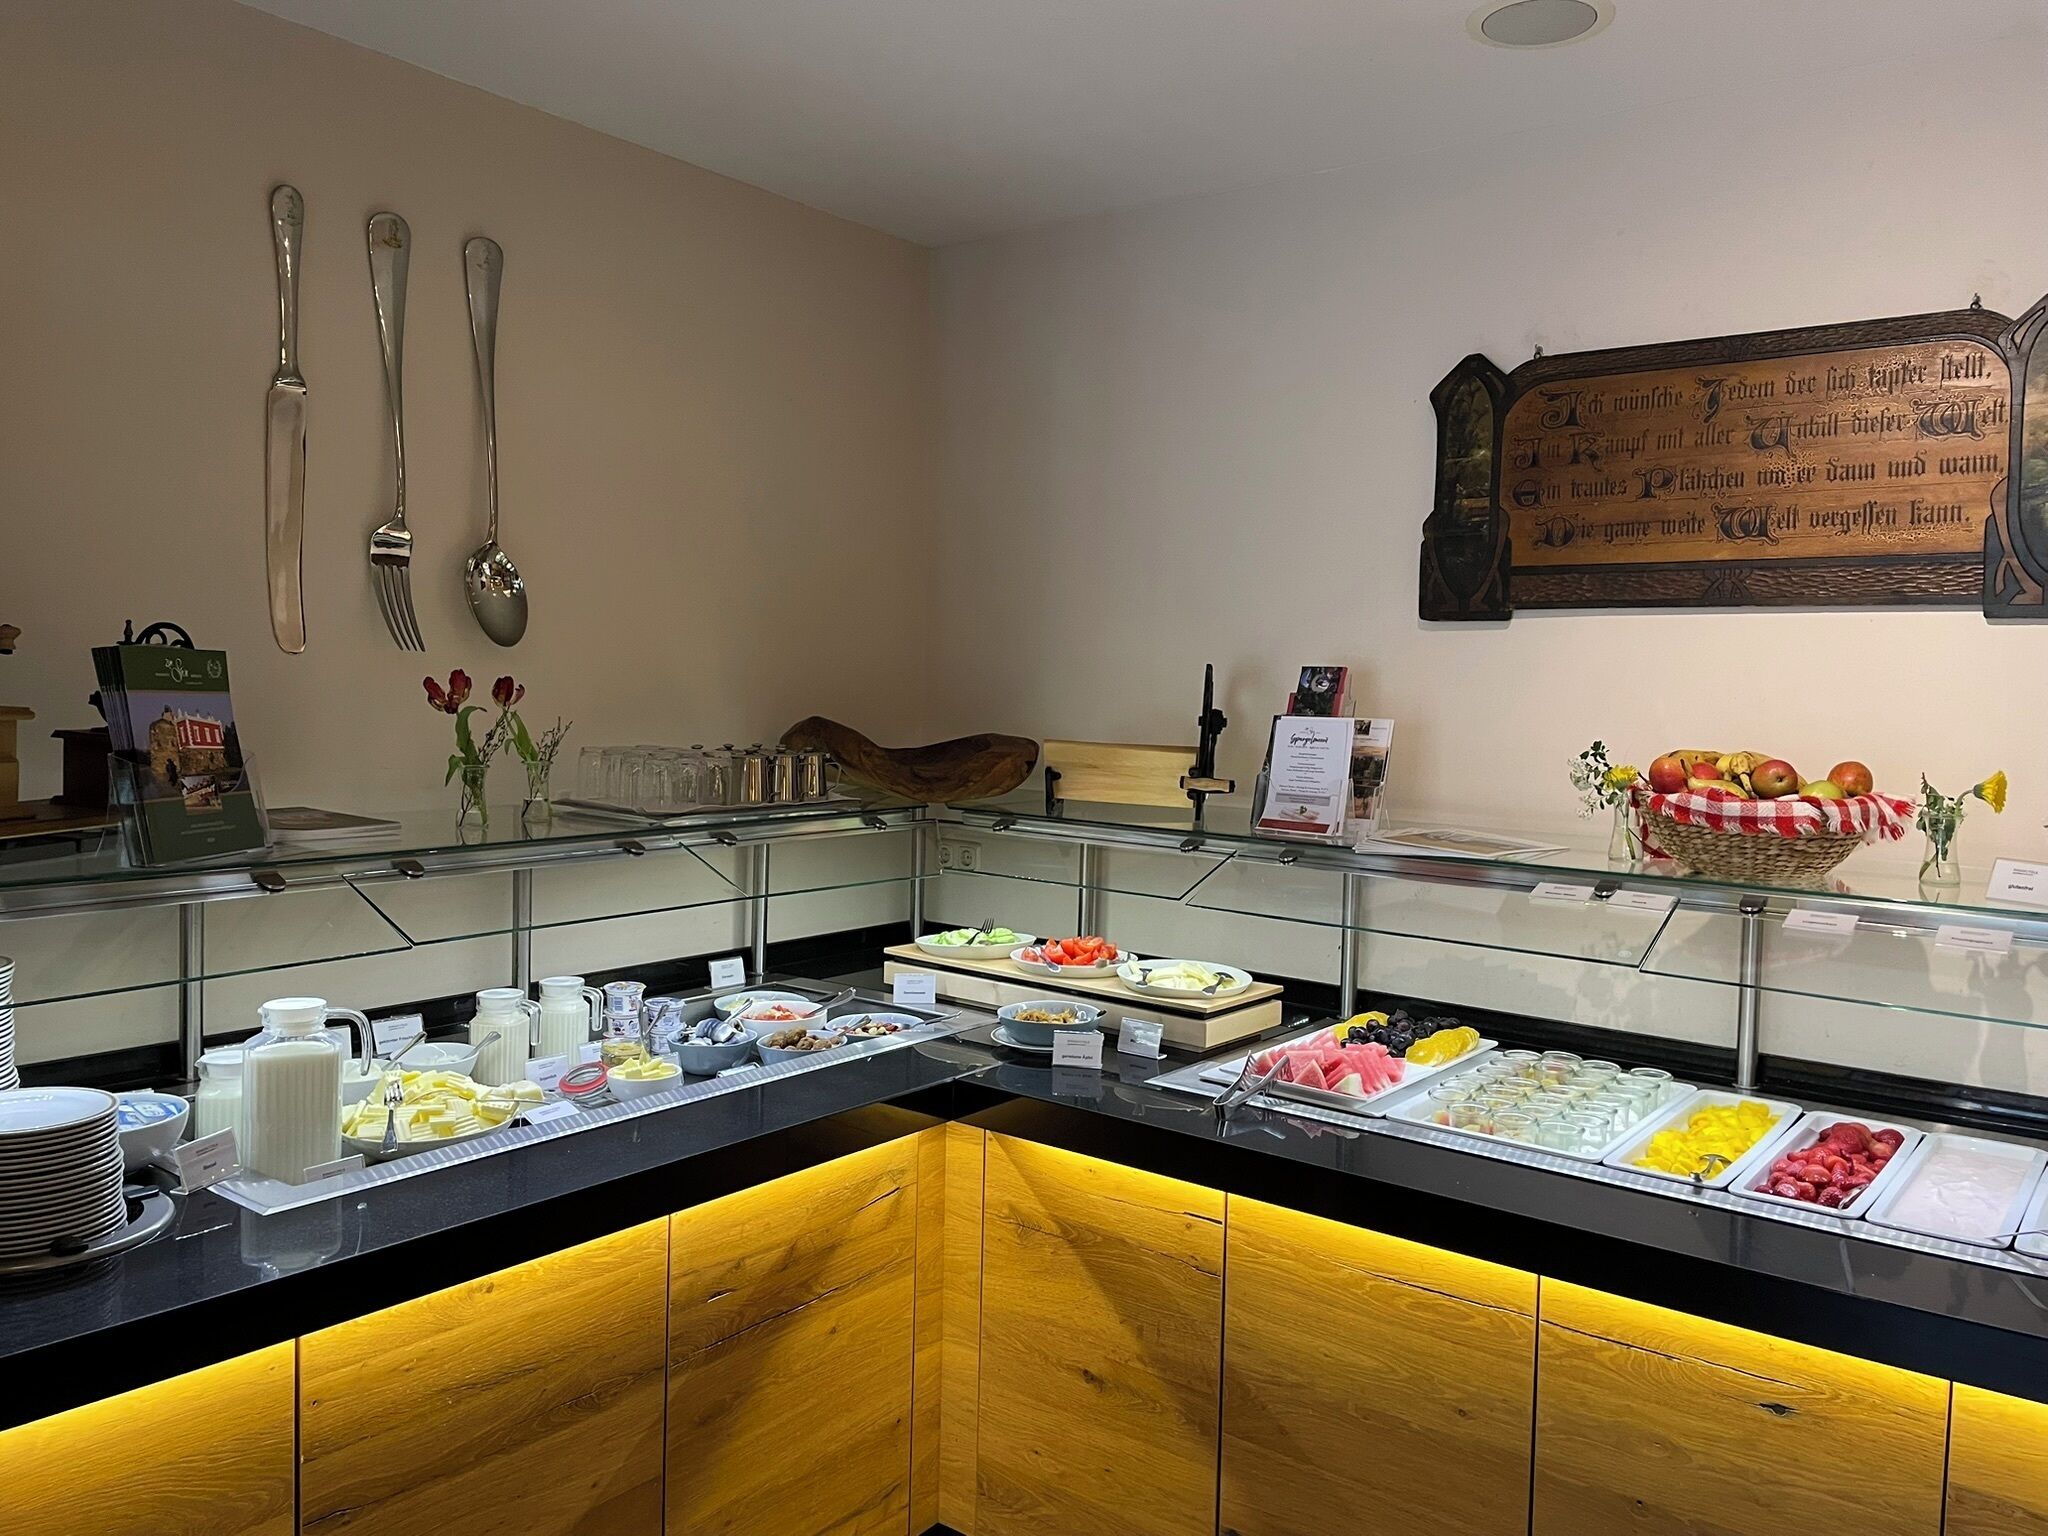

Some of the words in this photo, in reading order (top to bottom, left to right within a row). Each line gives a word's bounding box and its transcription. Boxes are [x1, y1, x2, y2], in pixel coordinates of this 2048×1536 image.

[1539, 388, 1603, 428] Ich
[1613, 384, 1683, 412] wünsche
[1695, 376, 1775, 423] Jedem
[1785, 371, 1816, 396] der
[1826, 366, 1856, 398] sich
[1867, 357, 1926, 394] tapfer
[1569, 432, 1648, 470] Kampf
[1656, 429, 1684, 450] mit
[1695, 424, 1734, 448] aller
[1852, 407, 1906, 442] dieser
[1512, 479, 1561, 507] Ein
[1571, 478, 1628, 498] trautes
[1826, 457, 1875, 482] dann
[1888, 449, 1927, 478] und
[1535, 514, 1595, 547] Die
[1603, 520, 1650, 544] ganze
[1661, 511, 1706, 536] weite
[1712, 502, 1798, 545] Welt
[1809, 500, 1898, 535] vergessen
[1909, 498, 1970, 525] kann.
